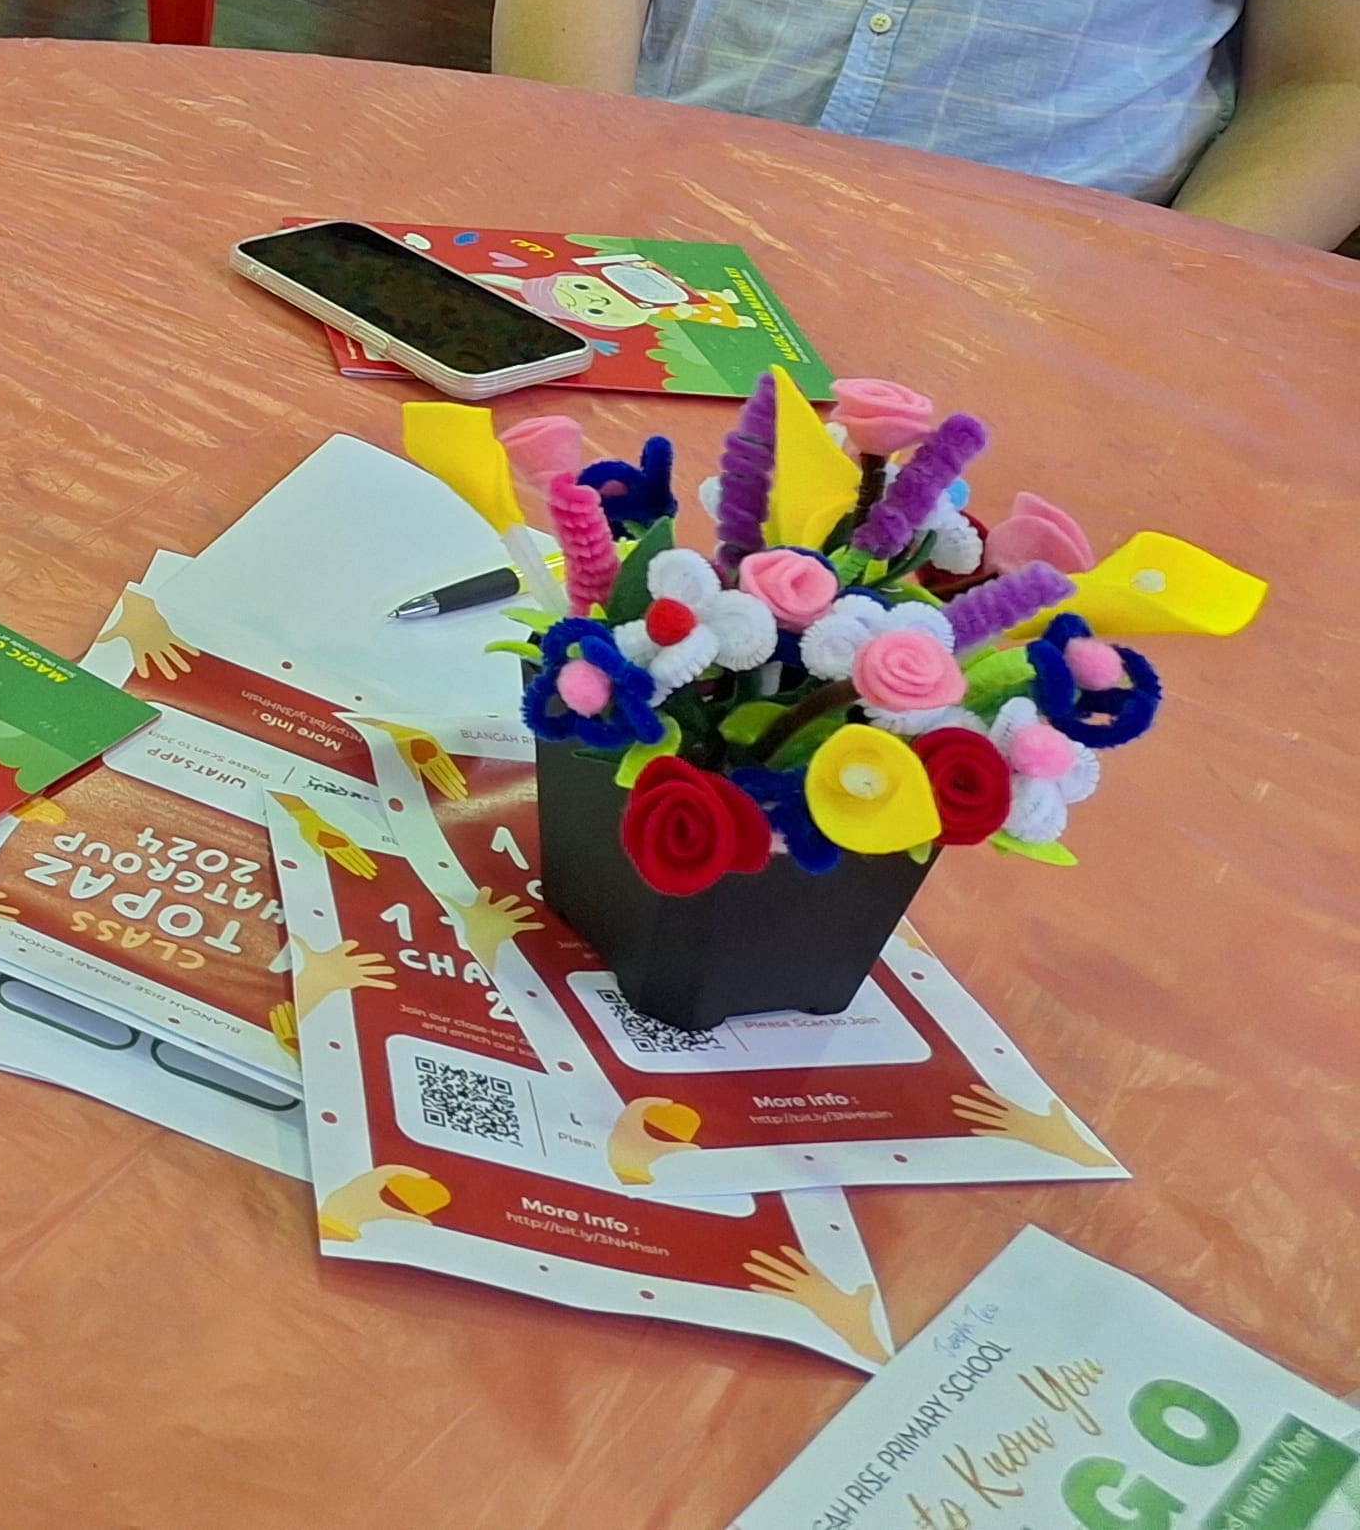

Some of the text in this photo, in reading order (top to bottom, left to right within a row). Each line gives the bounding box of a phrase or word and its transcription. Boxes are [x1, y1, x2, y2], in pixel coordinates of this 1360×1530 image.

[5, 647, 68, 683] MAGIC
[259, 712, 342, 752] More Info
[146, 746, 248, 790] WHATSAPP
[136, 827, 261, 883] 2024
[24, 851, 242, 954] TOPAZ
[8, 929, 63, 960] SCHOOL
[70, 910, 206, 970] CLASS
[752, 1093, 849, 1108] More Info
[520, 1196, 630, 1234] More Info
[845, 1462, 892, 1506] RISE
[876, 1394, 952, 1471] PRIMARY
[939, 1340, 1012, 1402] SCHOOL
[942, 1416, 1056, 1511] Know
[1017, 1356, 1105, 1437] You
